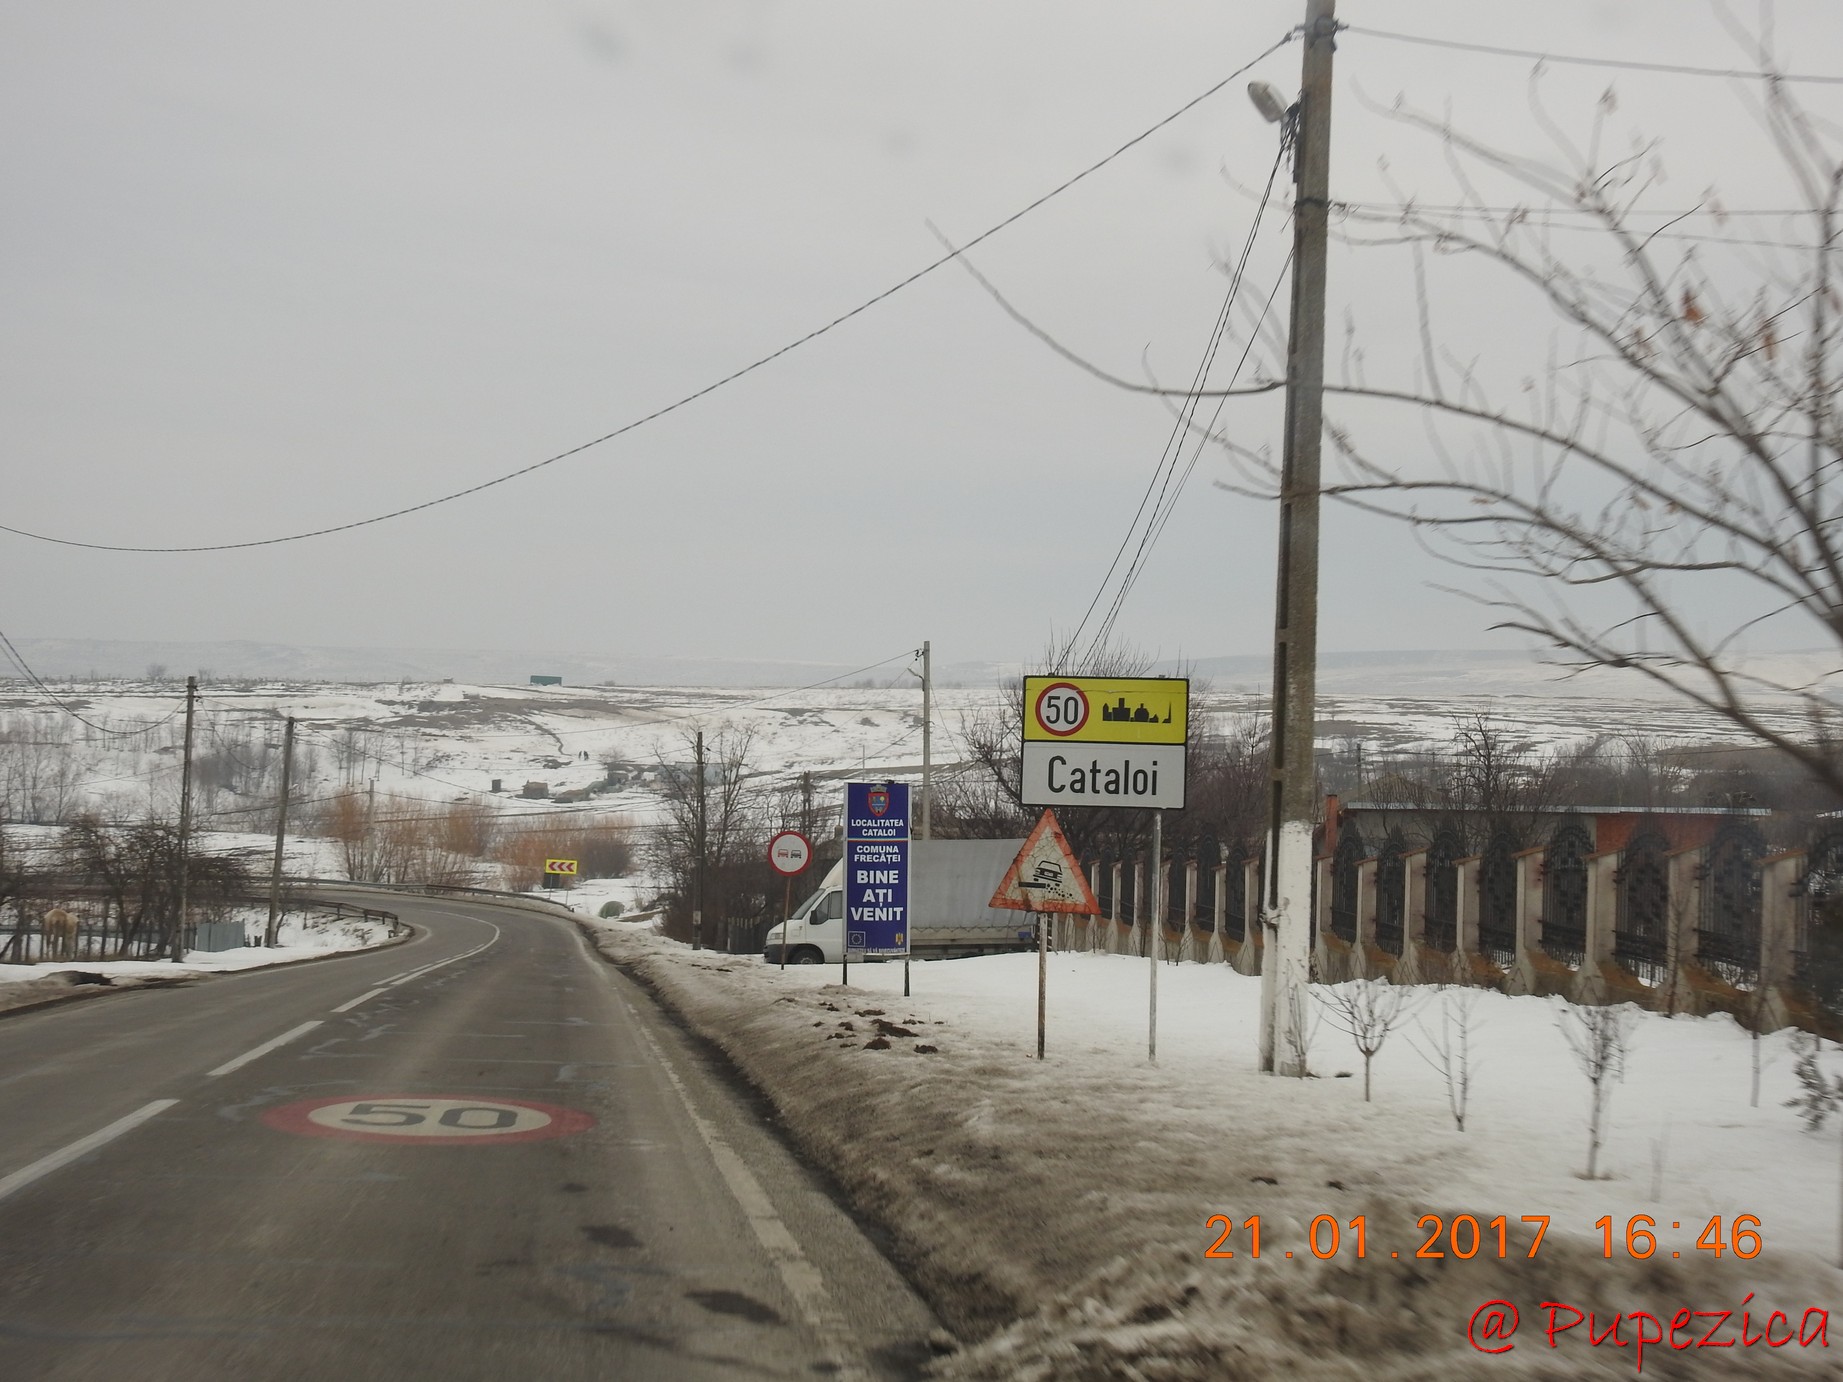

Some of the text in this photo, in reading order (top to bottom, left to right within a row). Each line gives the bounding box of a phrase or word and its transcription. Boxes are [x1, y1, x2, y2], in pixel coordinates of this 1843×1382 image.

[1046, 696, 1079, 725] 50
[1048, 755, 1158, 796] Cataloi
[851, 819, 904, 827] LOCALITATEA
[856, 845, 899, 853] COMUNA
[857, 870, 899, 884] BINE
[851, 907, 904, 921] VENIT
[341, 1103, 518, 1129] 50
